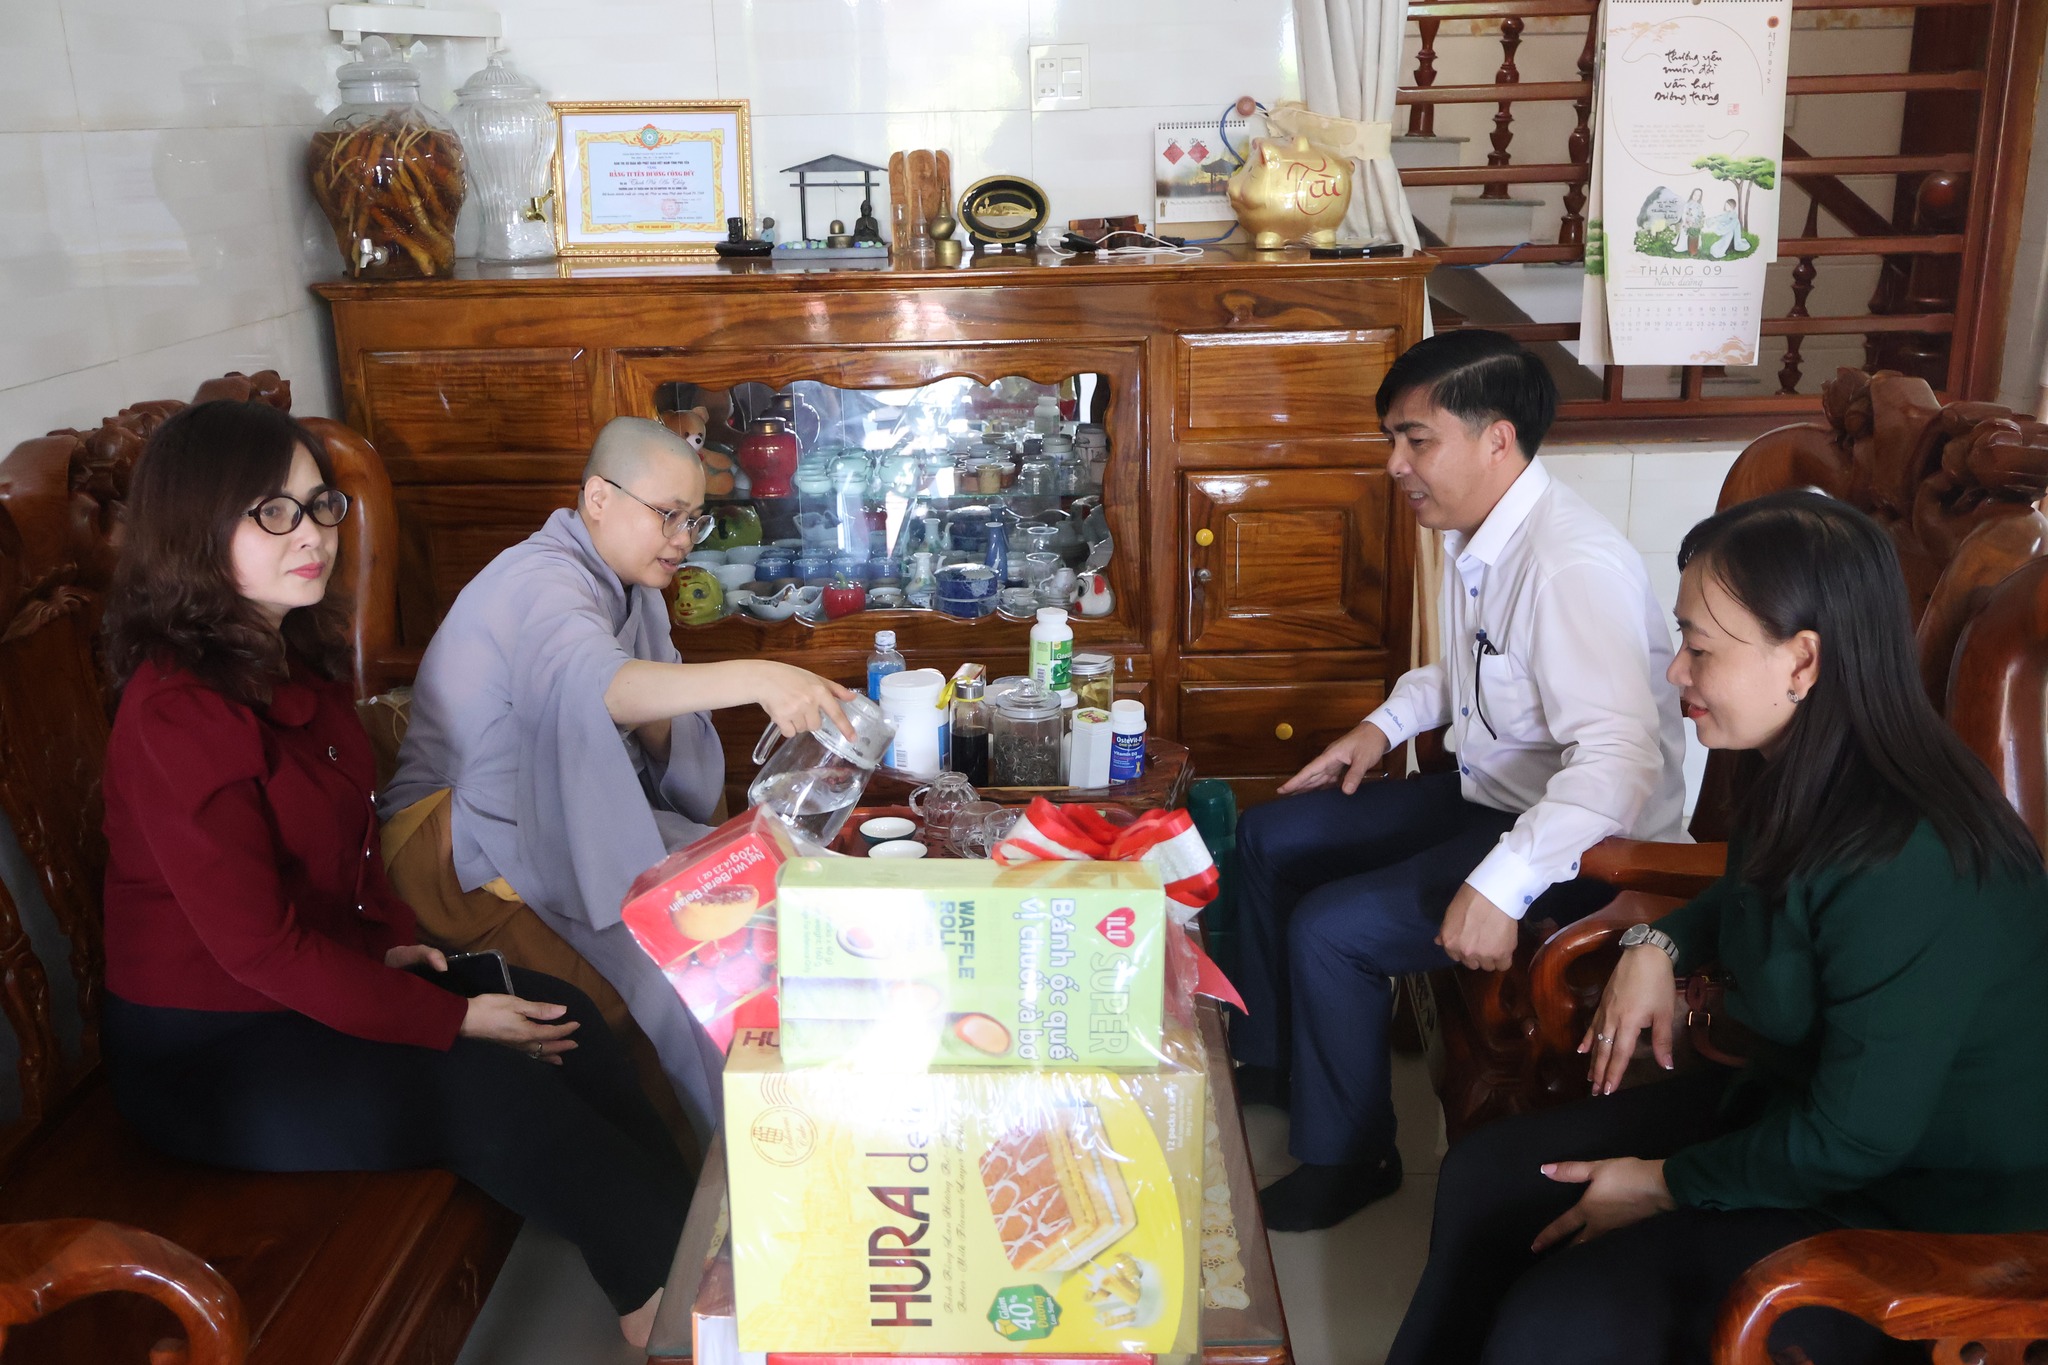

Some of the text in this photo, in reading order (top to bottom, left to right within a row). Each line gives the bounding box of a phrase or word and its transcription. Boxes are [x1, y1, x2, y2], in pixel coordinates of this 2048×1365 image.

[1287, 158, 1342, 216] Tài
[1640, 264, 1723, 276] THÁNG 09
[747, 852, 766, 866] Net
[938, 900, 957, 952] ROLL
[1013, 898, 1046, 922] vị
[1104, 916, 1128, 941] ILU
[958, 900, 976, 980] WAFFLE
[1044, 898, 1080, 1062] Bánh ốc quế
[1018, 999, 1044, 1025] và
[1088, 951, 1132, 1054] SUPER
[1018, 1029, 1045, 1061] bơ
[866, 1186, 932, 1328] HURA
